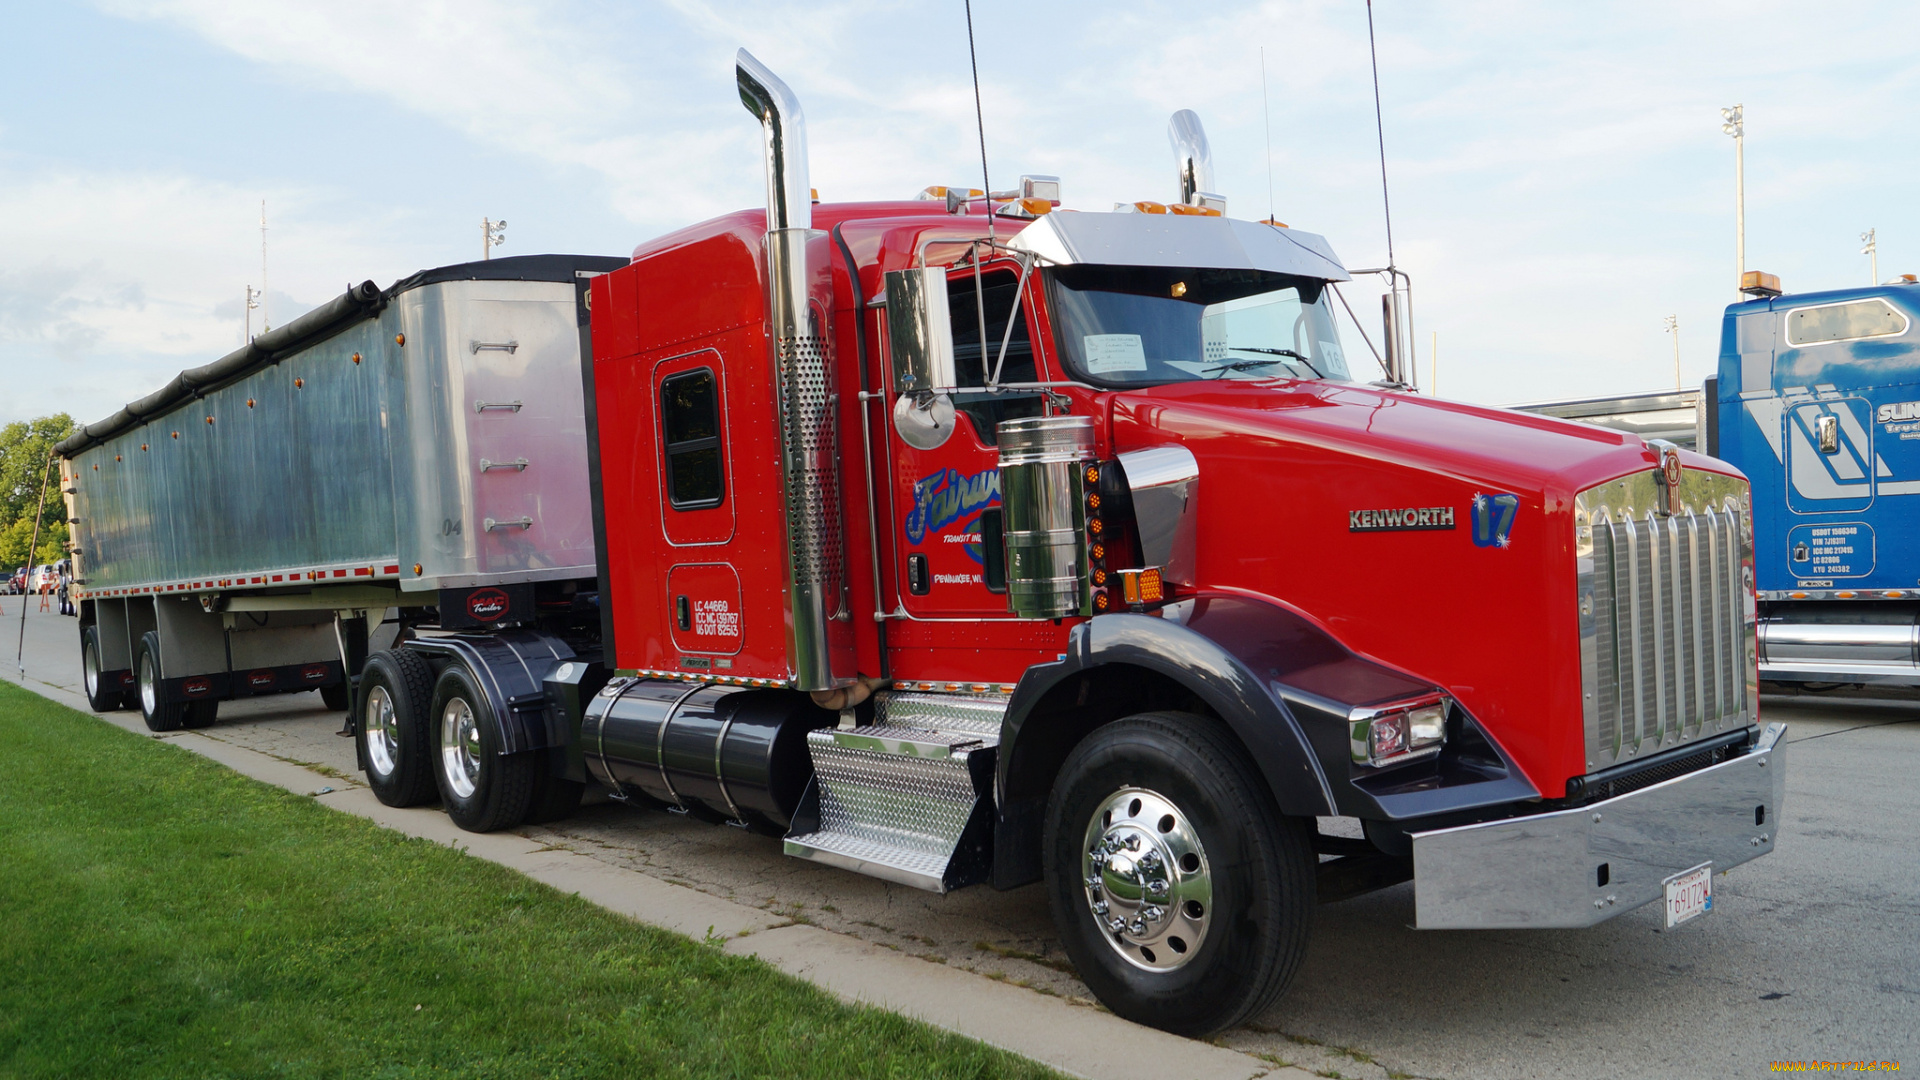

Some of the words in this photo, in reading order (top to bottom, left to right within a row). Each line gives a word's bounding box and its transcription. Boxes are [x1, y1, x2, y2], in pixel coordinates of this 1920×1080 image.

[1349, 506, 1455, 529] KENWORTH
[1471, 492, 1520, 549] 17
[1812, 528, 1831, 536] USDOT
[943, 533, 971, 543] TRANSIT
[1812, 538, 1823, 546] VIN
[1812, 547, 1823, 555] ICC
[1823, 547, 1833, 555] MC
[1812, 556, 1820, 564] LC
[934, 573, 973, 586] PEWAUKEE,
[473, 603, 503, 613] Trailer
[694, 601, 703, 611] LC
[704, 601, 728, 612] 44669
[695, 613, 706, 623] ICC
[706, 613, 716, 623] MC
[716, 613, 738, 624] 139767
[704, 624, 717, 635] DOT
[717, 624, 738, 637] 82513
